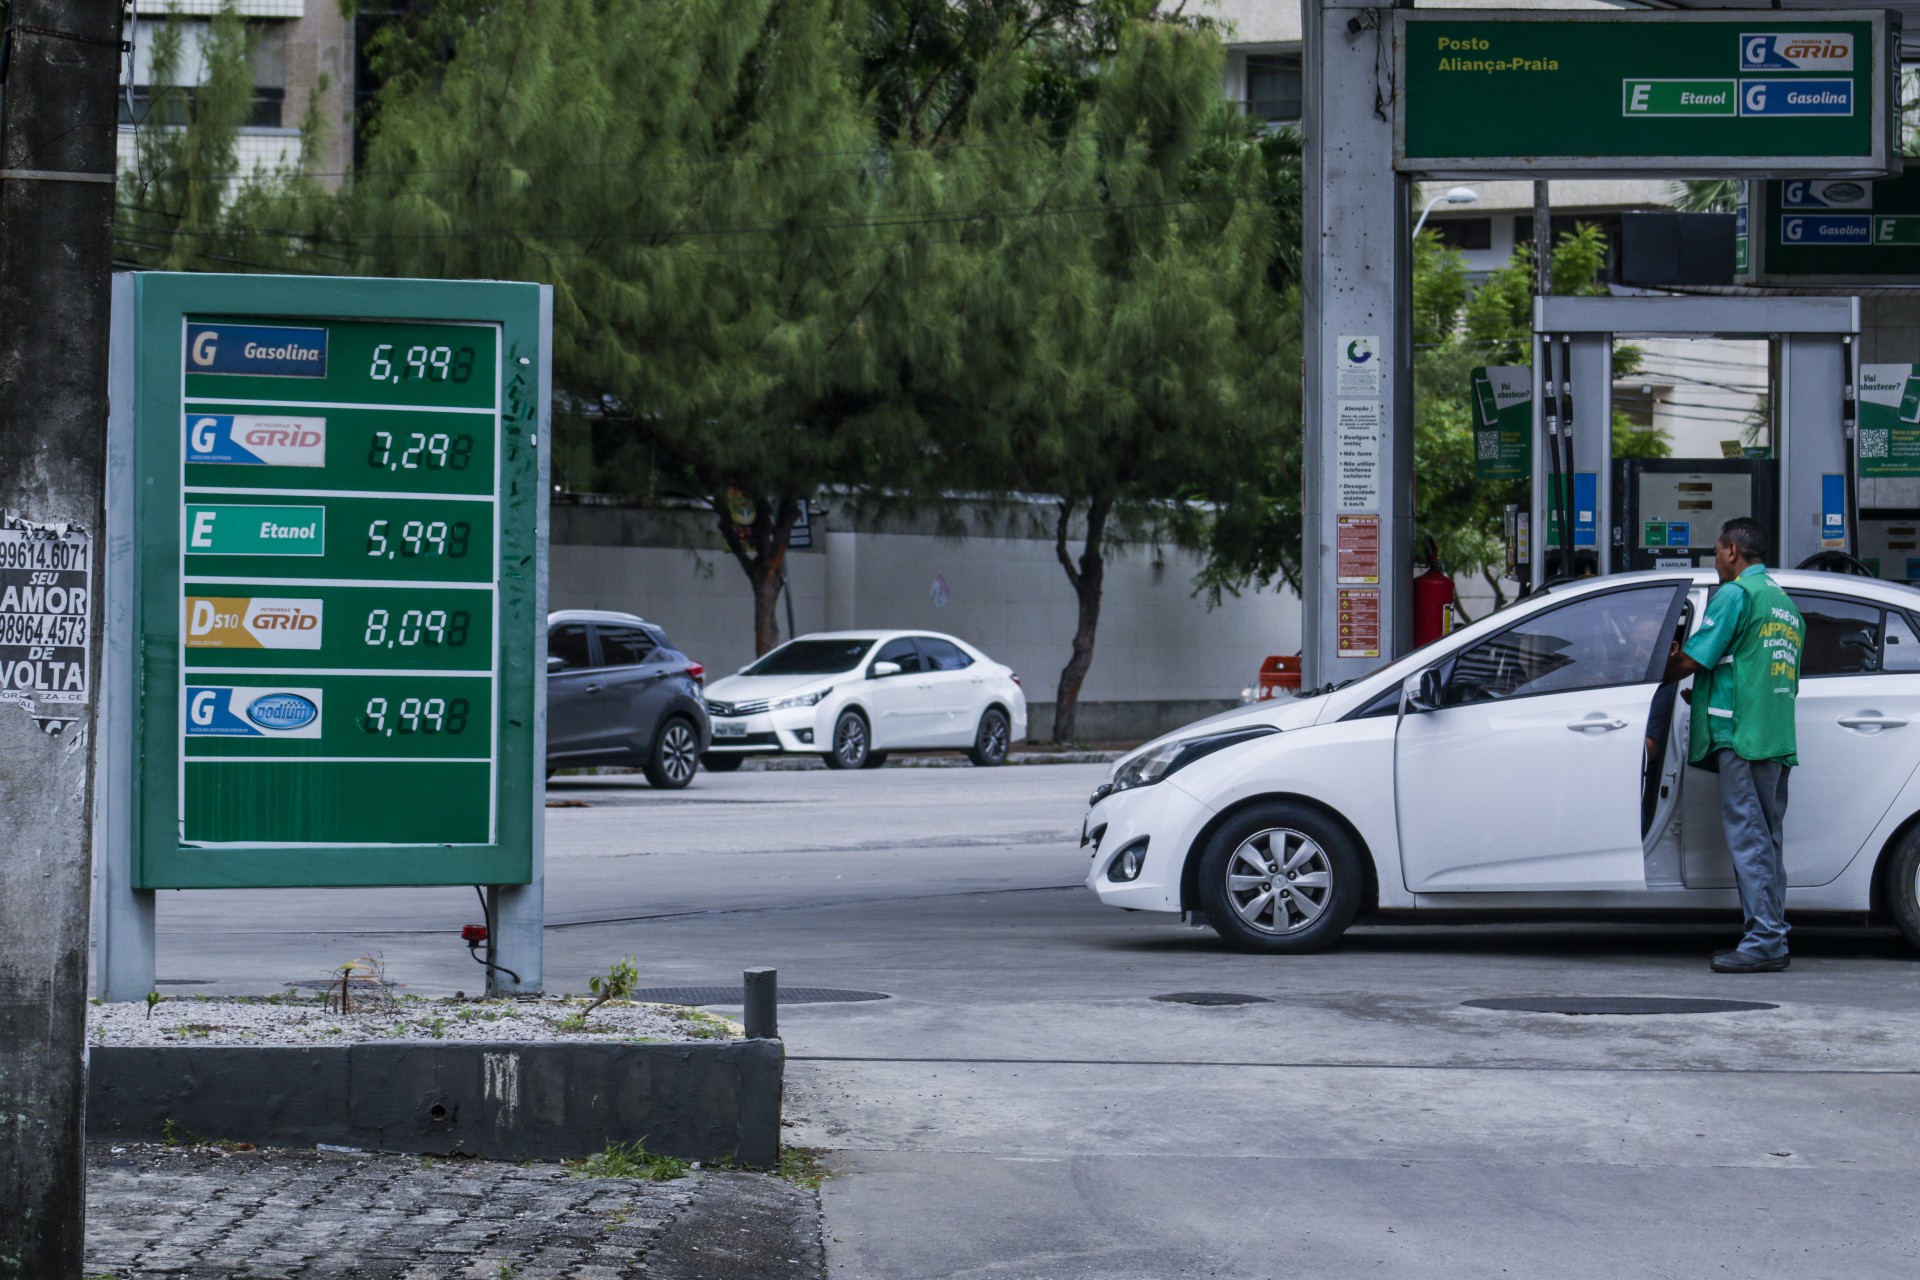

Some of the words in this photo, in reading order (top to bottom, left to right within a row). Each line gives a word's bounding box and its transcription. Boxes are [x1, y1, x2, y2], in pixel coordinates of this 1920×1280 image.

[1438, 37, 1490, 50] Posto
[1745, 37, 1767, 64] G
[1783, 40, 1849, 59] GRID
[1438, 57, 1559, 74] Aliança-Praia
[1629, 84, 1652, 111] E
[1679, 92, 1727, 105] Etanol
[1745, 84, 1767, 112] G
[1786, 92, 1848, 105] Gasolina
[1786, 182, 1803, 203] G
[1786, 219, 1803, 240] G
[1818, 224, 1867, 236] Gasolina
[1878, 219, 1896, 241] E
[192, 331, 219, 367] G
[244, 342, 320, 361] Gasolina
[370, 344, 452, 384] 6,99
[1501, 382, 1511, 390] Vai
[1859, 382, 1901, 391] abastecer?
[1863, 374, 1877, 382] Vai
[1497, 390, 1531, 399] abastecer?
[191, 417, 218, 453] G
[245, 424, 322, 448] GRID
[375, 431, 450, 472] 7,29
[191, 511, 217, 547] E
[259, 521, 316, 539] Etanol
[367, 520, 448, 560] 5,99
[0, 542, 87, 570] 99614.6071
[29, 571, 60, 585] SEU
[0, 585, 87, 614] AMOR
[0, 614, 87, 645] 98964.4573
[252, 608, 318, 631] GRID
[365, 609, 447, 649] 8,09
[28, 646, 55, 660] DE
[0, 660, 84, 691] VOLTA
[191, 690, 217, 726] G
[366, 697, 445, 738] 9,99
